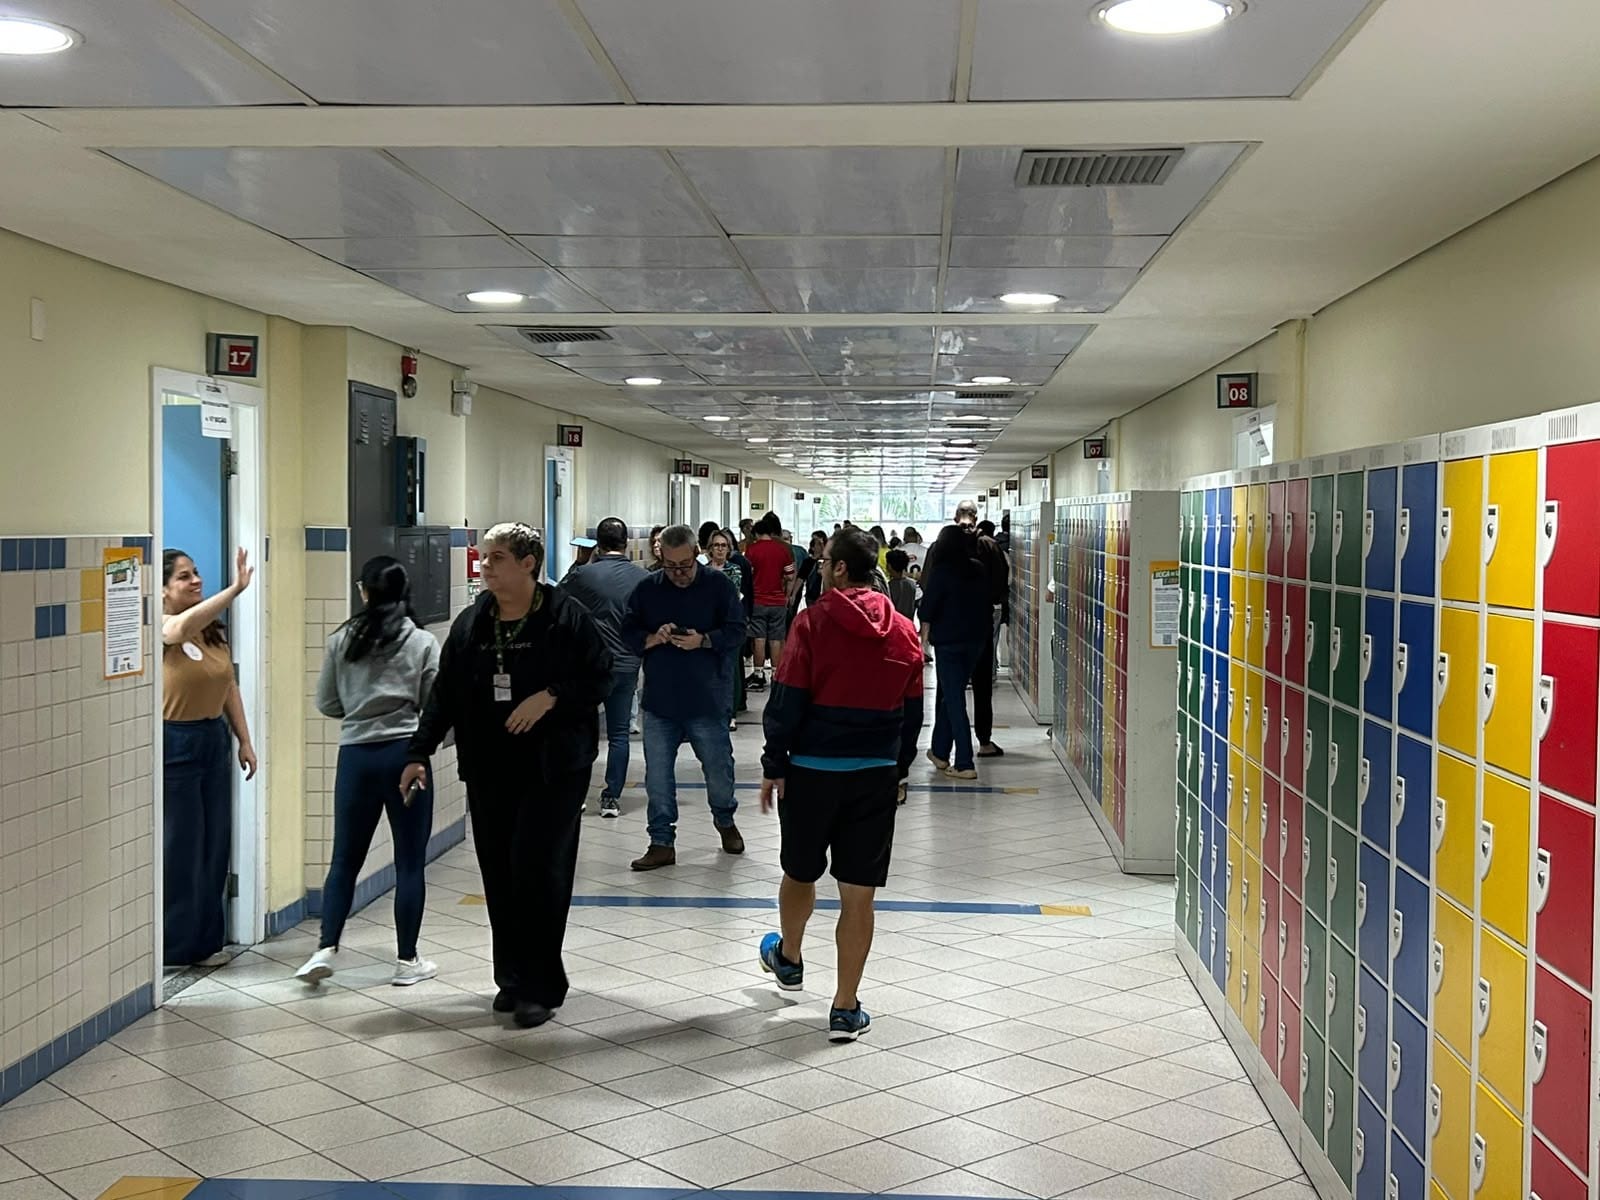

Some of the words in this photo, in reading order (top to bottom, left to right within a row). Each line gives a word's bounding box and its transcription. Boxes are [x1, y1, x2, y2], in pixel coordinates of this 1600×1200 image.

[229, 351, 251, 366] 17
[1229, 387, 1248, 401] 08
[568, 433, 580, 443] 18
[1090, 446, 1102, 455] 07
